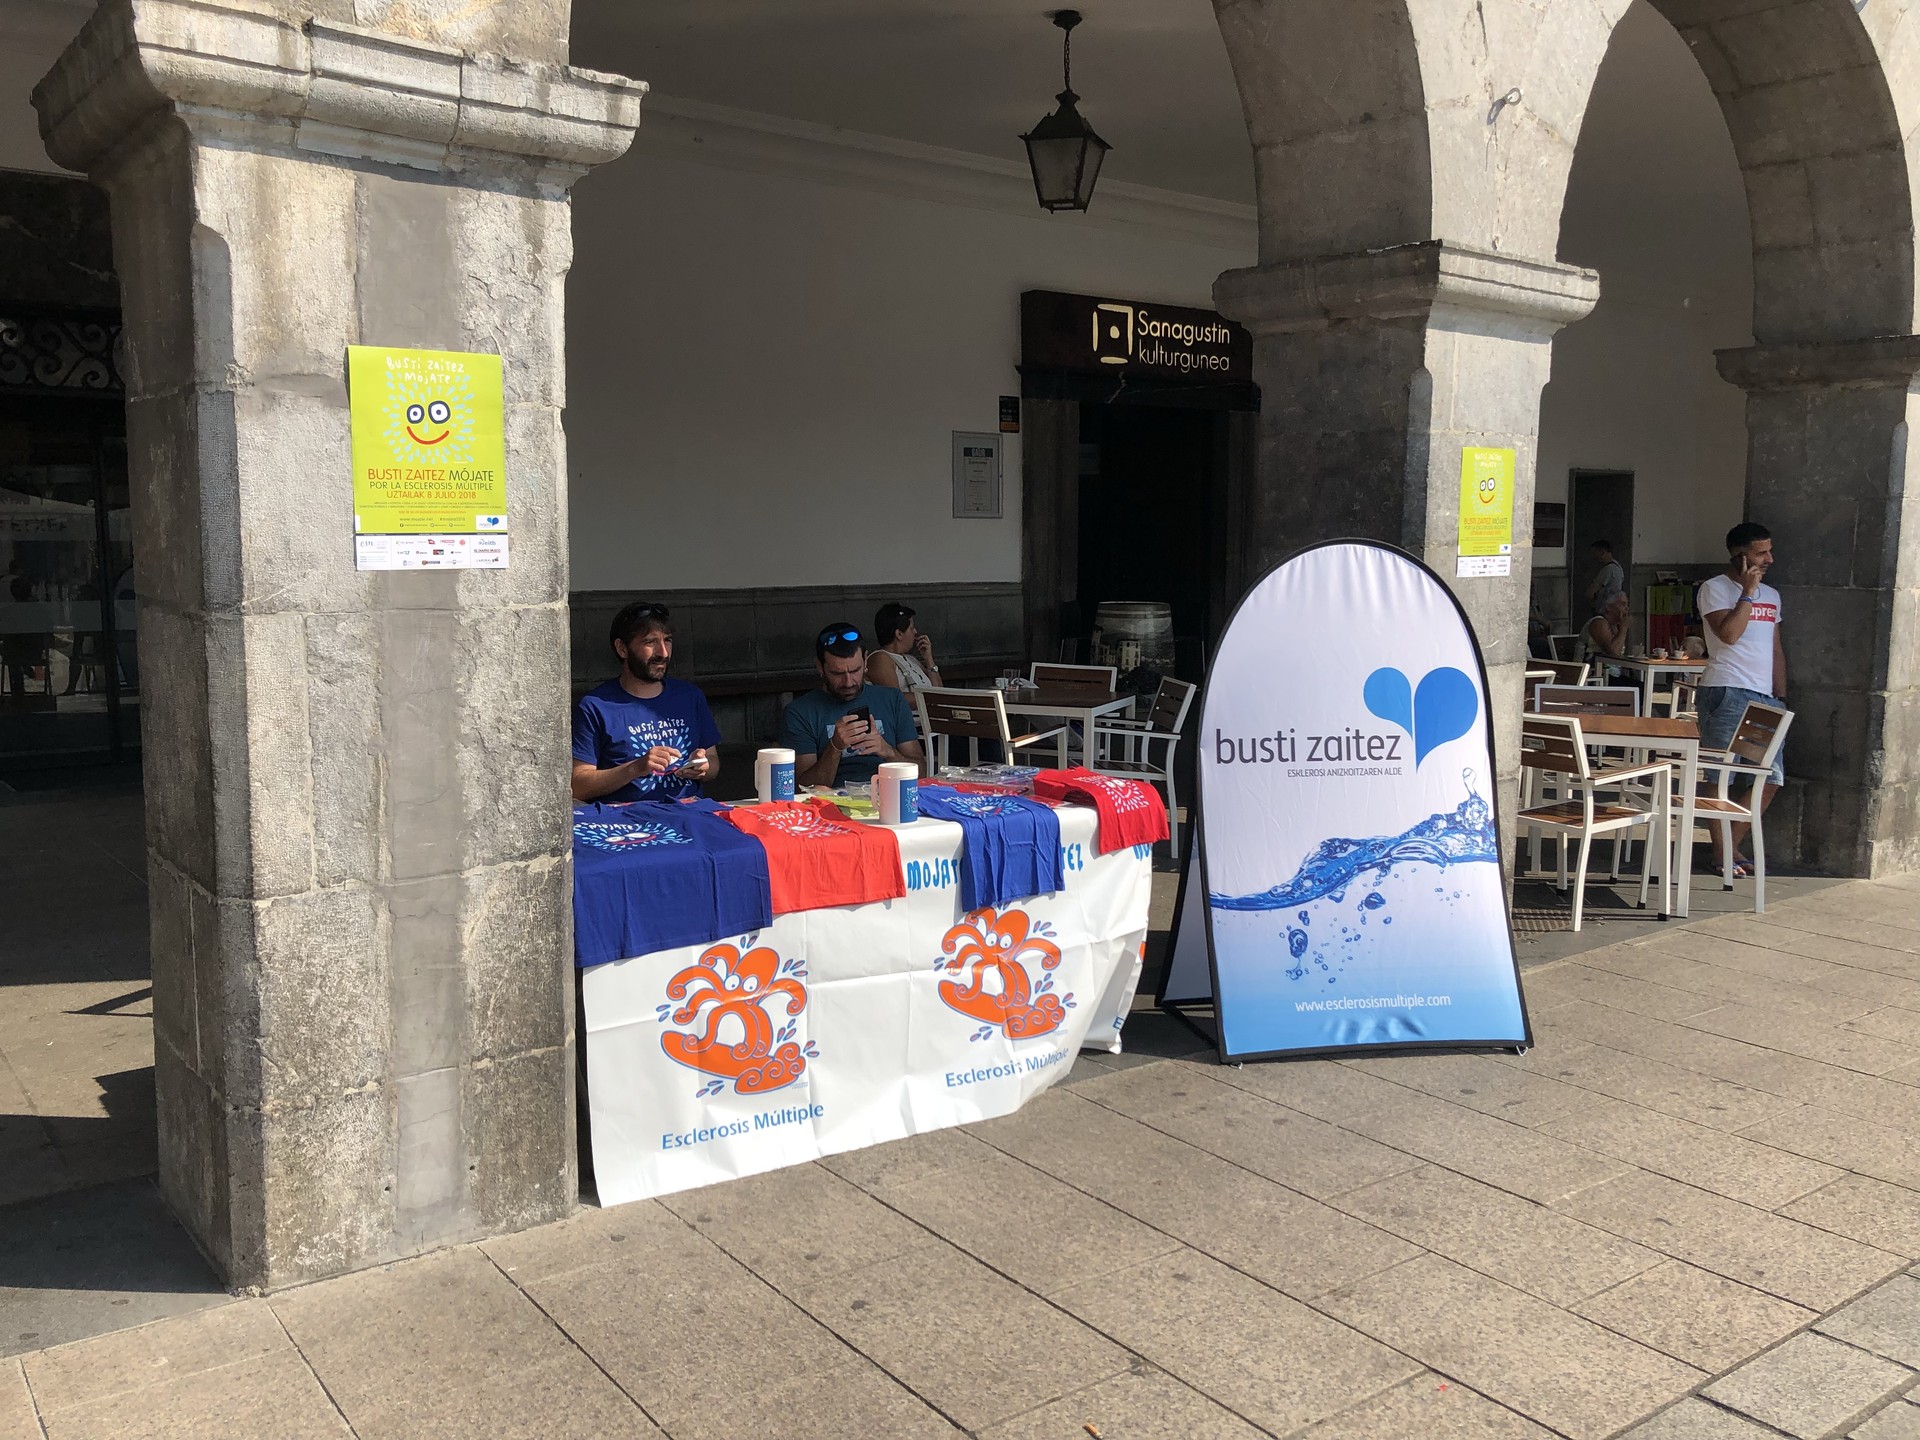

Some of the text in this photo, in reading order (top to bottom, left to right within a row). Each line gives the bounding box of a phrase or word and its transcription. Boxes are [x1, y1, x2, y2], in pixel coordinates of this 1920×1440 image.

[1138, 310, 1230, 346] Sanagustin
[1138, 339, 1230, 373] kulturgunea
[368, 467, 494, 482] BUSTI ZAITEZ MÓJATE
[370, 481, 388, 490] POR
[391, 482, 401, 490] LA
[404, 482, 453, 490] ESCLEROSIS
[387, 490, 477, 499] UZTAILAK 8 JULIO 2018
[1216, 727, 1402, 764] busti zaitez
[1287, 767, 1402, 778] ESKLEROSI ANIZKOITZAREN ALDE
[1295, 993, 1451, 1012] www.esclerosismultiple.com
[662, 1103, 824, 1150] Esclerosis Múltiple
